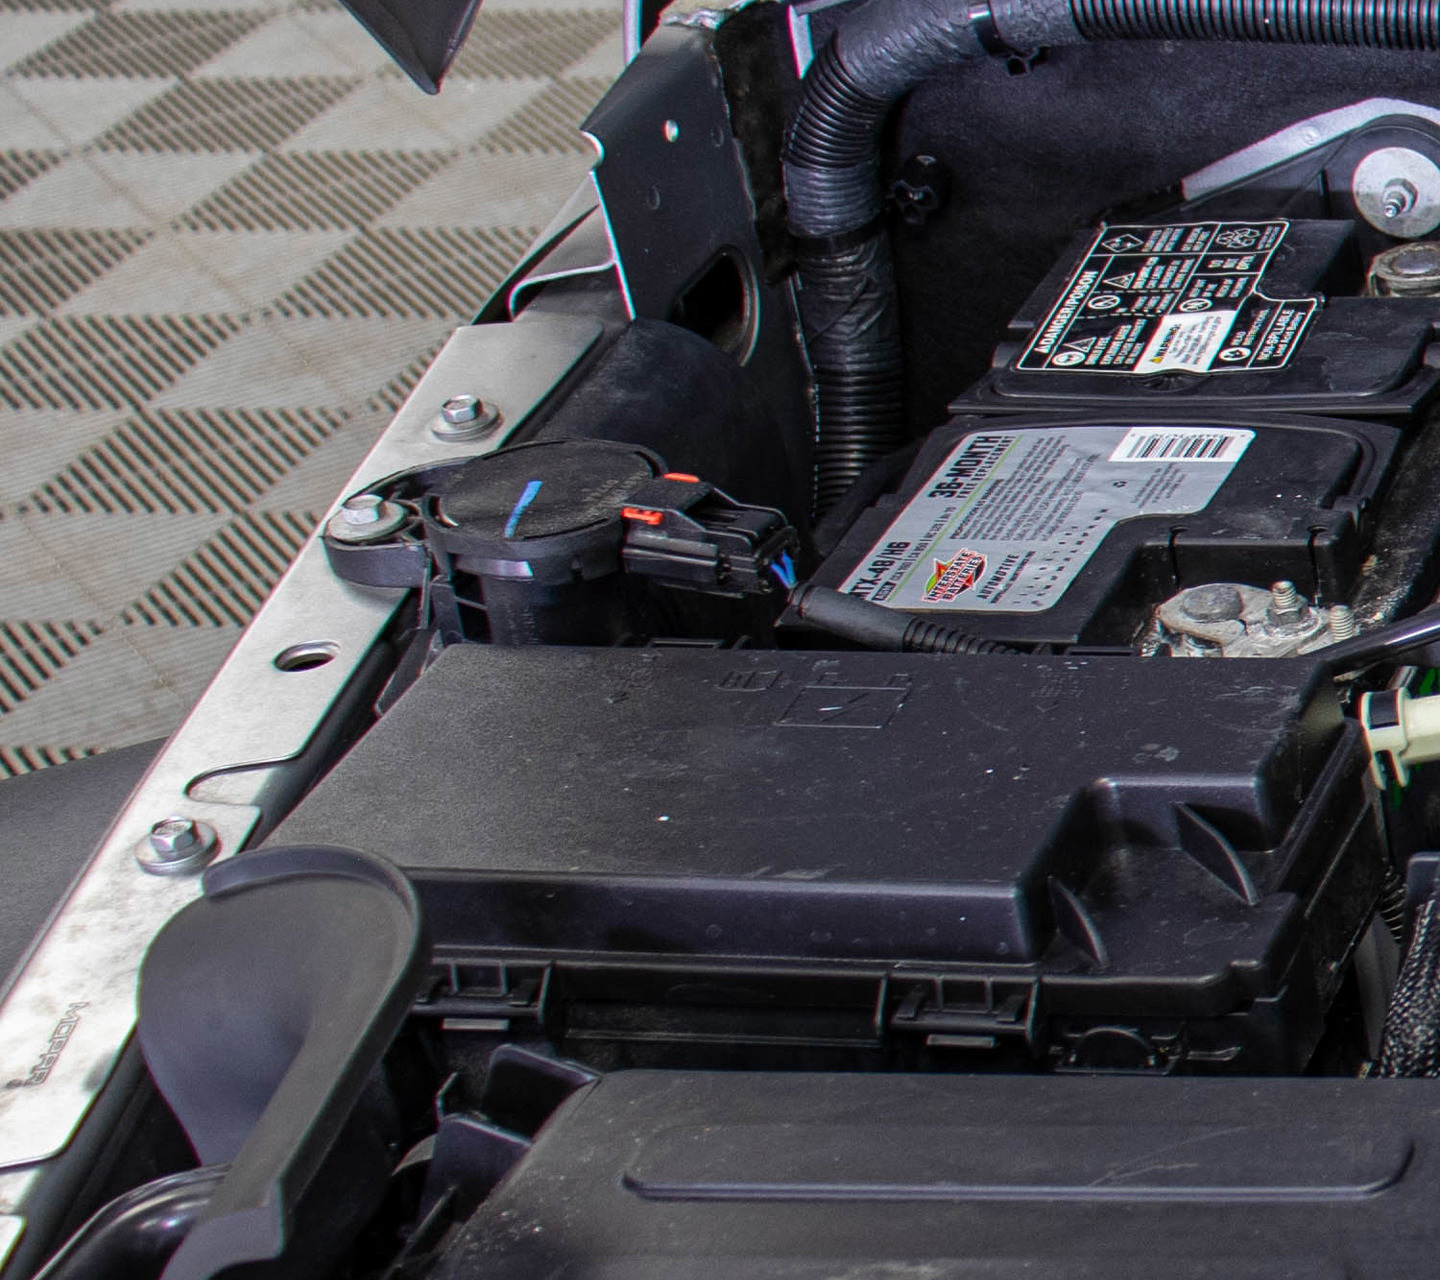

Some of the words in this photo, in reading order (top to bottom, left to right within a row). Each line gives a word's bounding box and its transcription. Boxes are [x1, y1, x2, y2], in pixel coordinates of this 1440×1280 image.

[1045, 271, 1100, 347] DANGER/POISON
[927, 435, 1003, 497] 36-MONTH
[954, 483, 978, 497] FREE
[969, 436, 1016, 480] REPLACEMENT
[926, 552, 971, 600] INTERSTATE
[941, 556, 983, 599] BATTERIES
[973, 554, 1020, 599] AUTOMOTIVE
